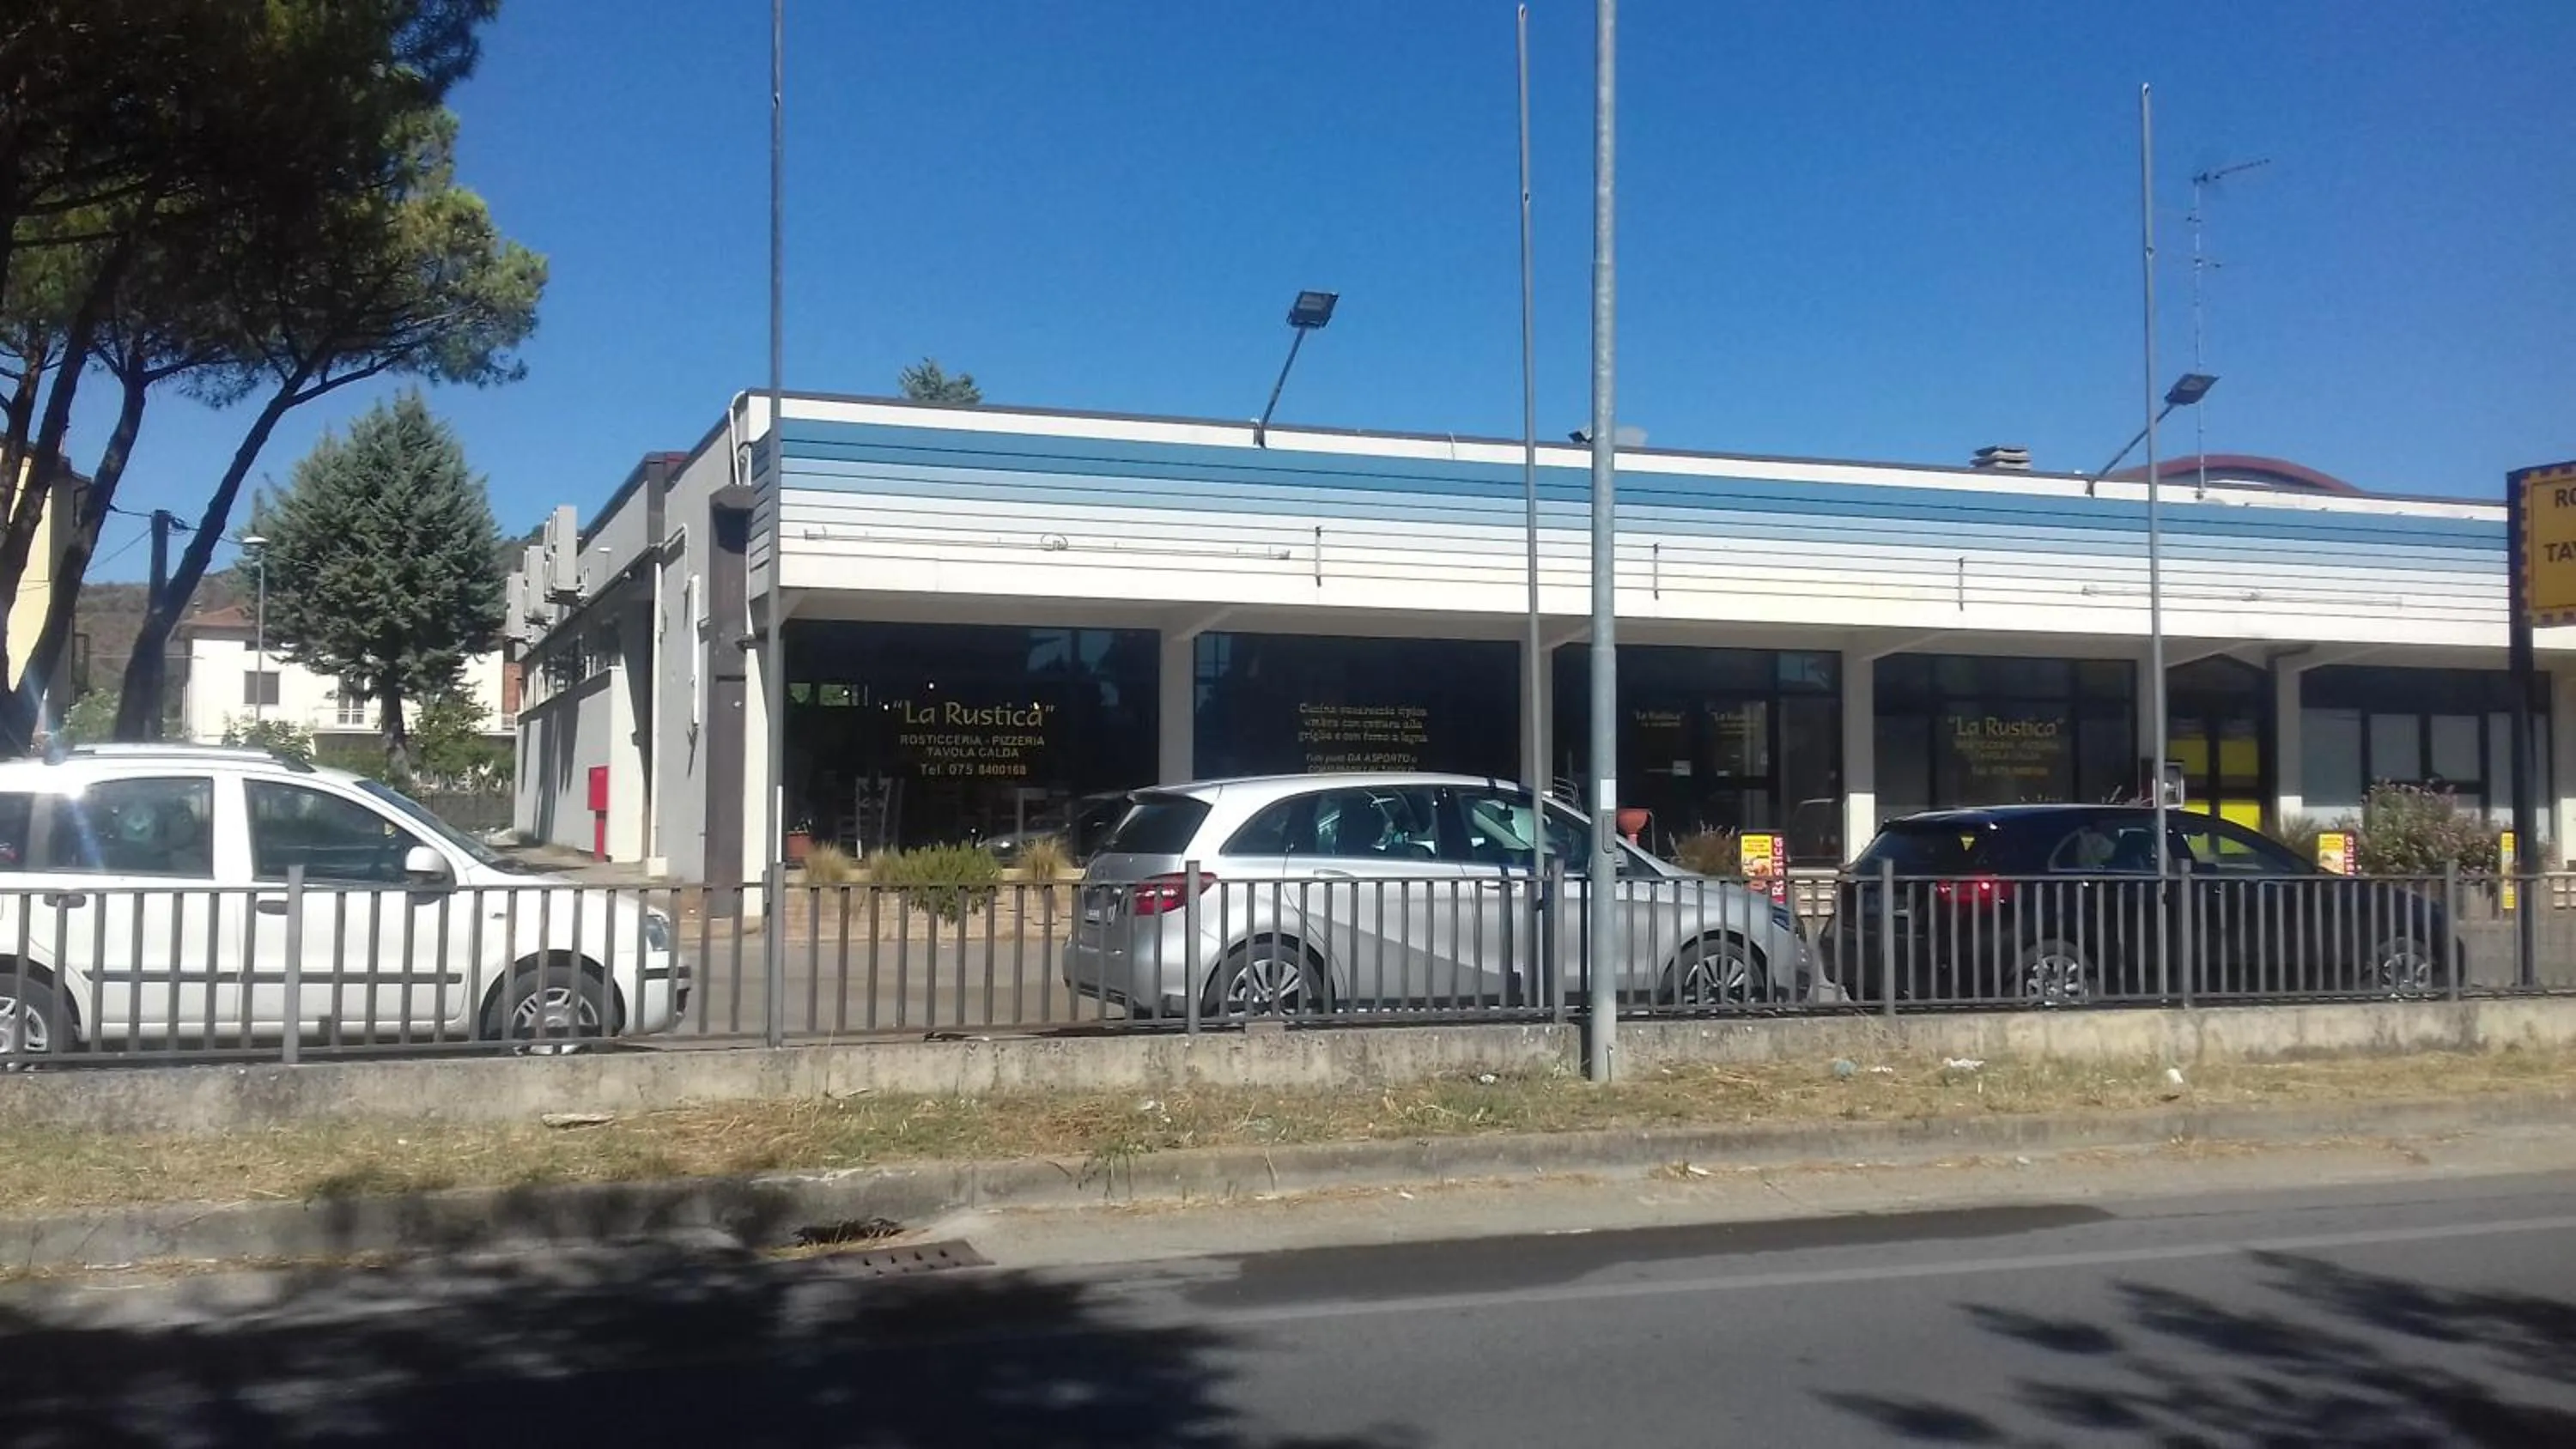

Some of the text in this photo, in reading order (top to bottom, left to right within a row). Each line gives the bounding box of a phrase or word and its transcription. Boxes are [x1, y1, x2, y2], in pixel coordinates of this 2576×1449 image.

[892, 700, 1055, 727] "La Rustica"
[992, 735, 1045, 747] PIZZERIA
[926, 746, 1019, 758] TAVOLA CALDA
